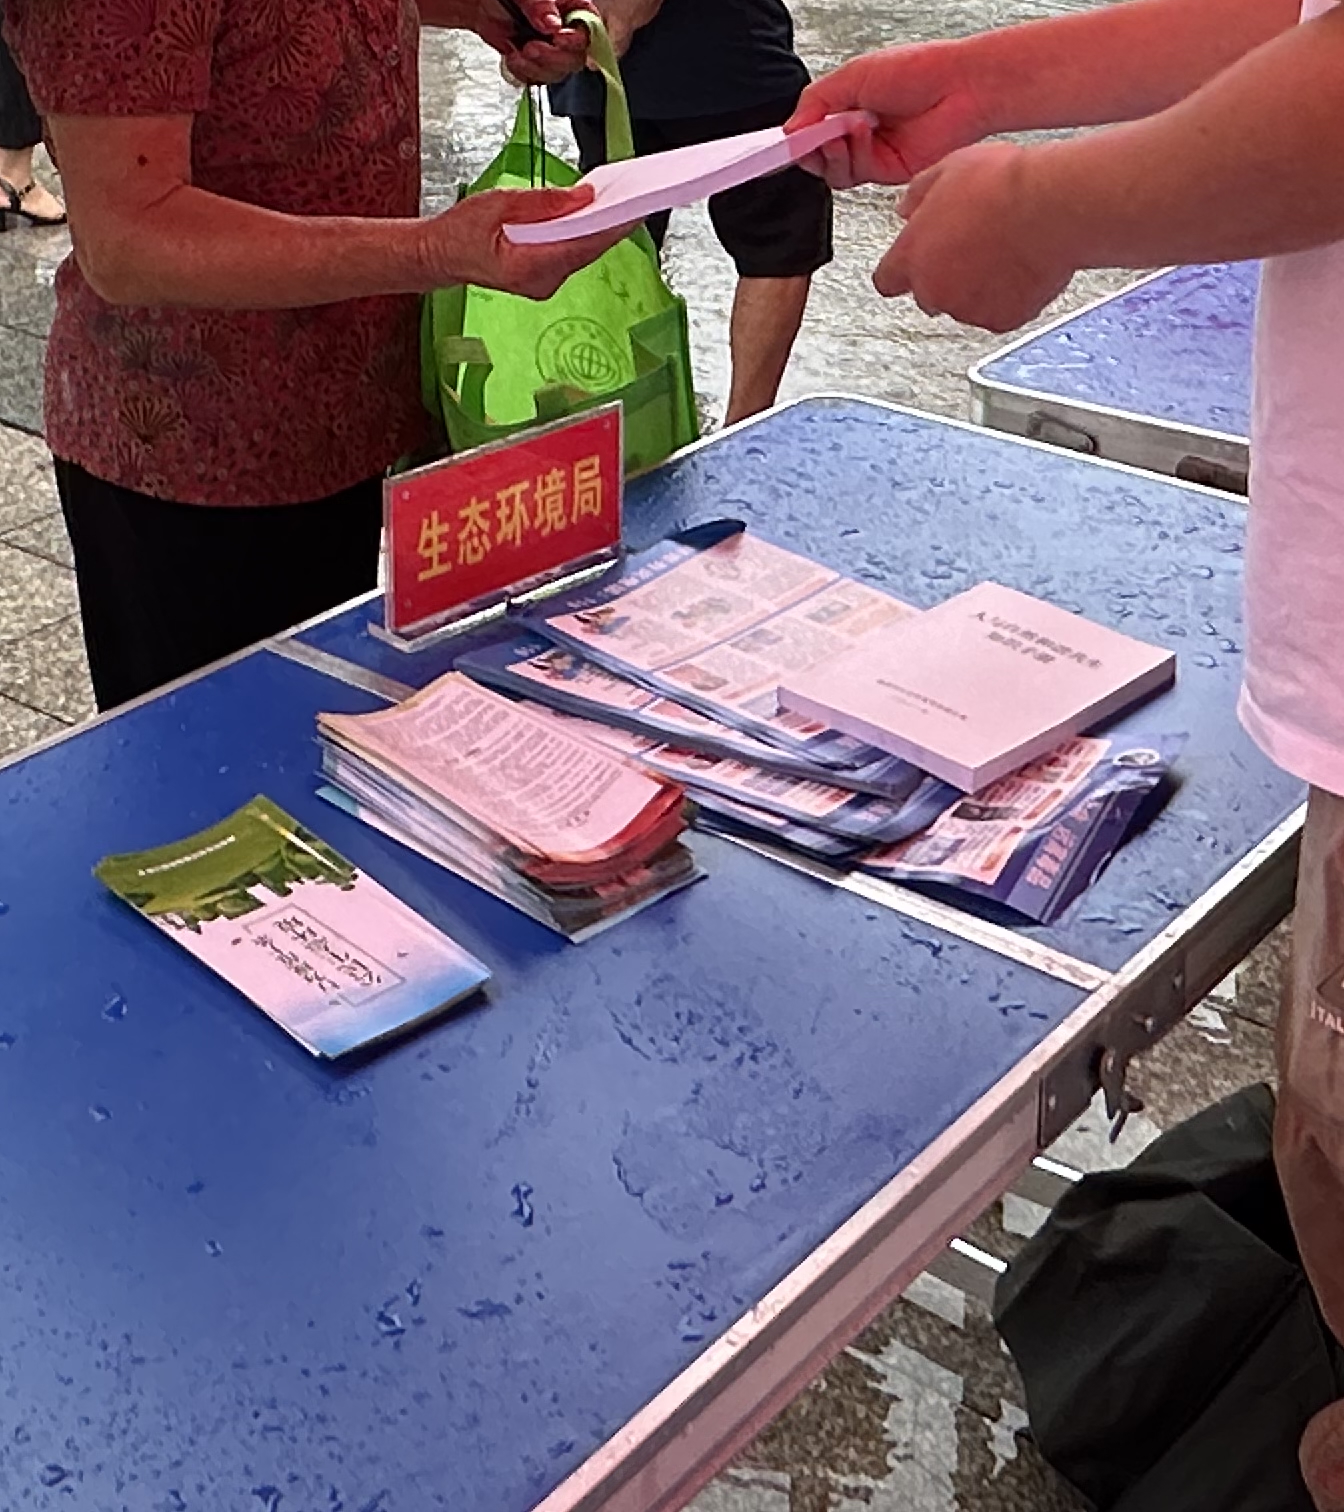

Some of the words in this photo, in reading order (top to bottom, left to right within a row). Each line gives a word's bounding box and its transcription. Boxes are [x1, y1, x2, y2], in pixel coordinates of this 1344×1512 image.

[416, 454, 603, 582] 生态环境局
